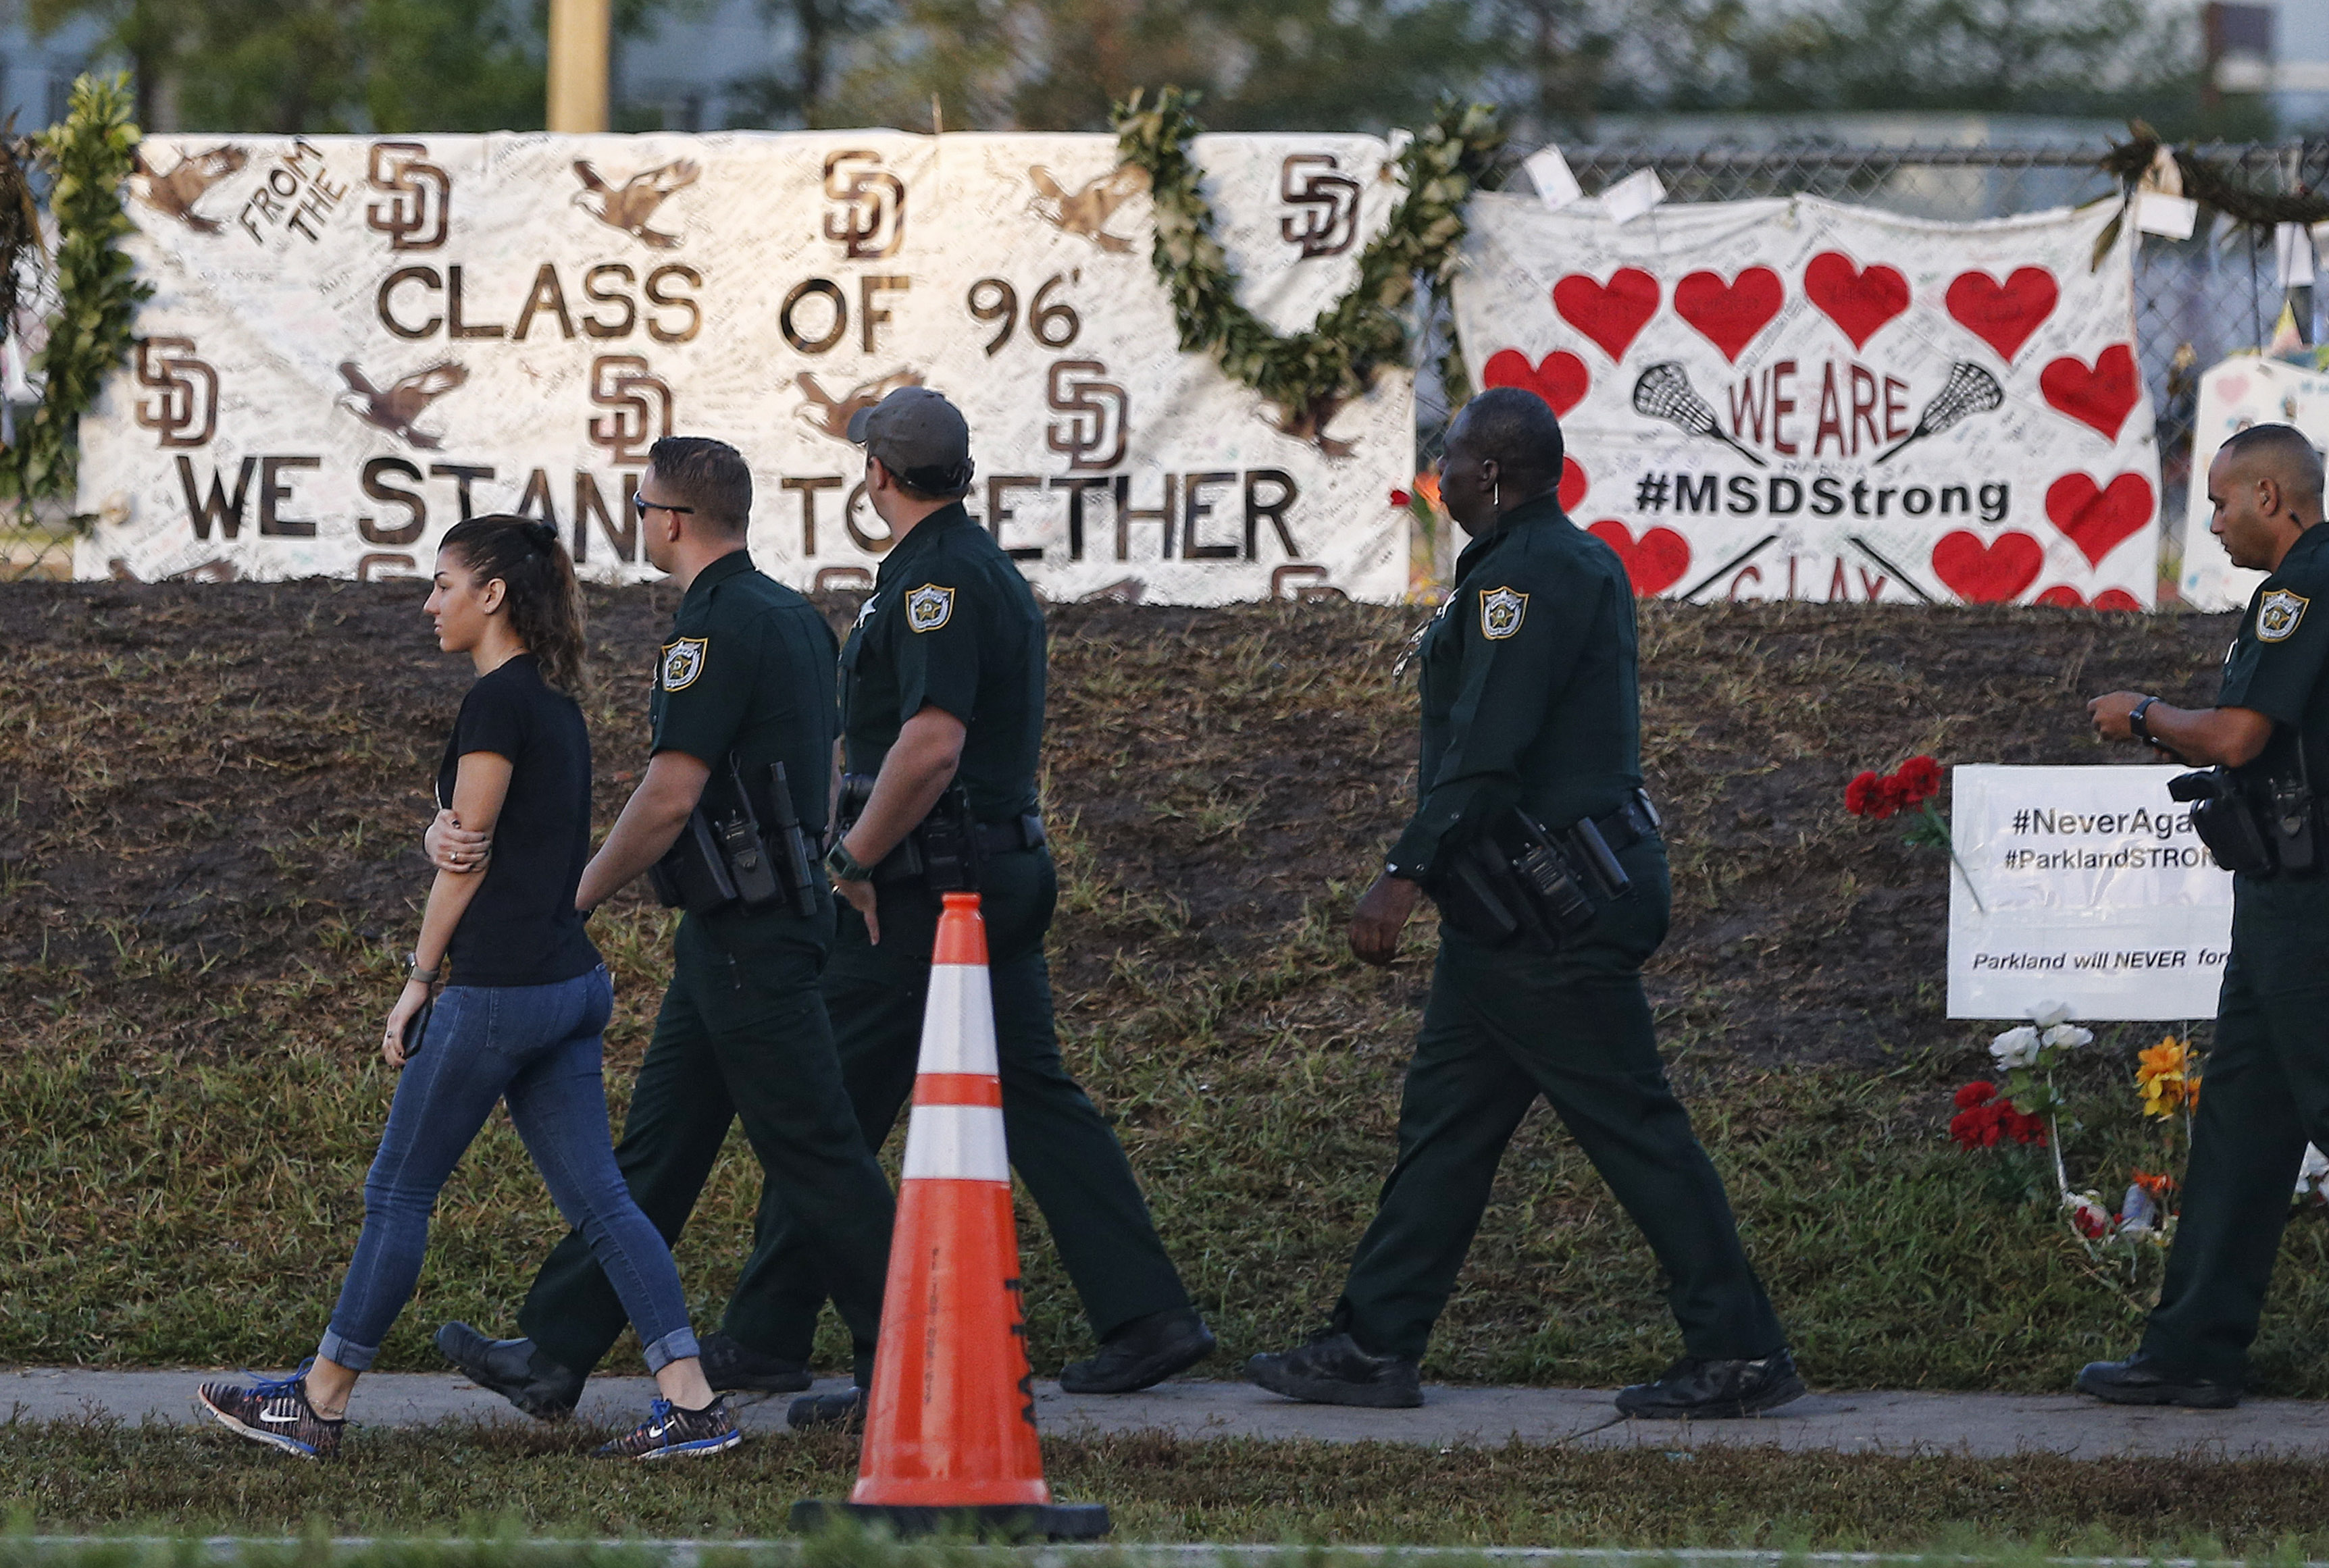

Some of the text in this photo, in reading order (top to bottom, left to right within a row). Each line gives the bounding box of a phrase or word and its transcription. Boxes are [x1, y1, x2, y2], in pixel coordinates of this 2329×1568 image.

[238, 140, 322, 244] FROM
[287, 168, 347, 242] THE
[377, 264, 702, 342] CLASS
[780, 276, 910, 355] OF
[1729, 362, 1910, 457] WE ARE
[177, 456, 321, 540] WE
[358, 457, 650, 564] STAN
[781, 470, 1300, 562] TOETHER
[1636, 473, 2010, 522] #MSDStrong
[2005, 847, 2217, 869] #ParklandSTRON
[2013, 808, 2193, 840] #NeverAga
[1973, 948, 2228, 970] Parkland will NEVER for
